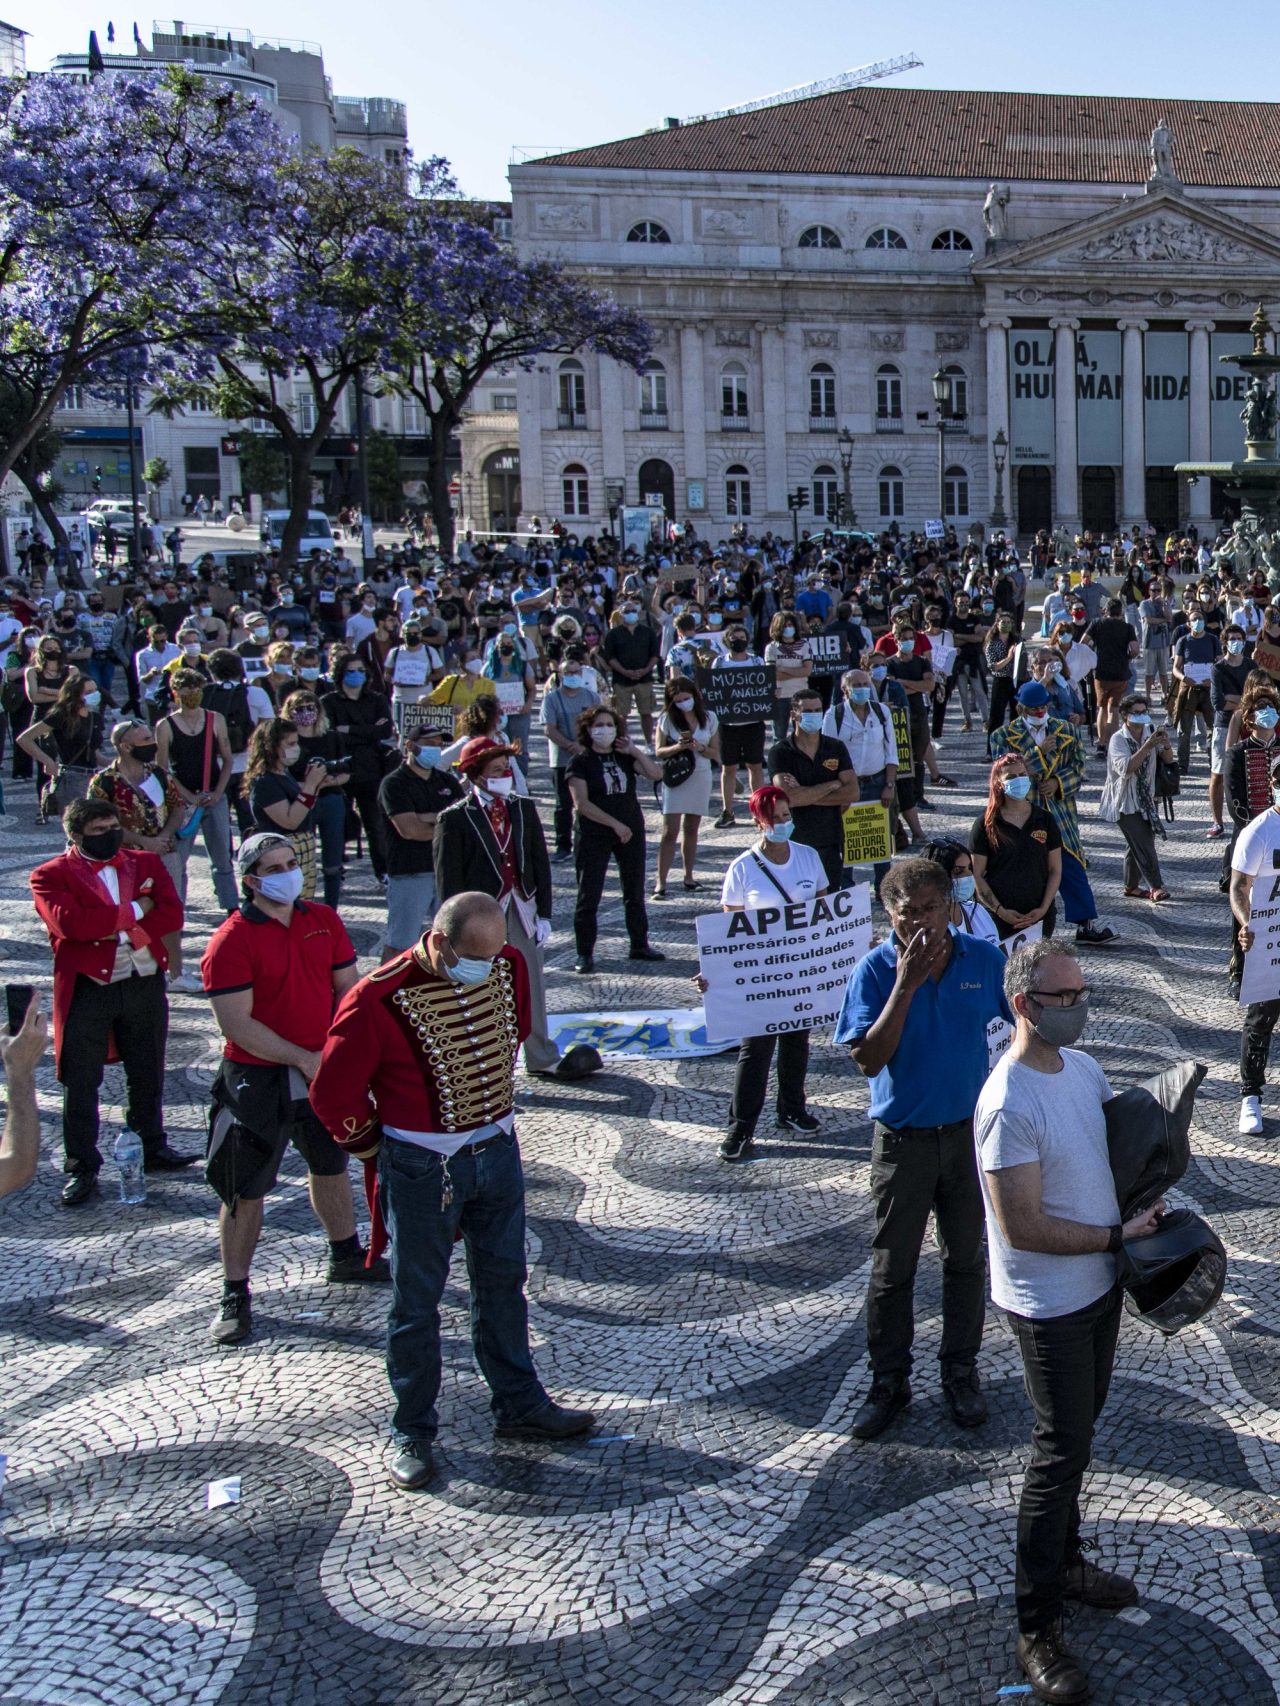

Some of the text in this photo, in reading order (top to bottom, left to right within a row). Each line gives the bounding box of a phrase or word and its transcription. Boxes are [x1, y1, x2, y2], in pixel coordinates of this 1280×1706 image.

[712, 672, 766, 687] MÚSICO
[404, 705, 453, 716] ACTIVIDADE
[716, 702, 773, 716] HÁ 65 DIAS
[404, 716, 452, 727] CULTURAL
[847, 834, 886, 849] CULTURAL
[848, 848, 861, 861] DO
[726, 891, 853, 939] APEAC
[702, 914, 872, 956] Empresários e Artistas
[733, 938, 855, 969] em dificuldades
[1267, 942, 1273, 950] o
[735, 955, 856, 986] o circo não têm
[746, 975, 850, 1002] nenhum apoi
[793, 1001, 813, 1013] do
